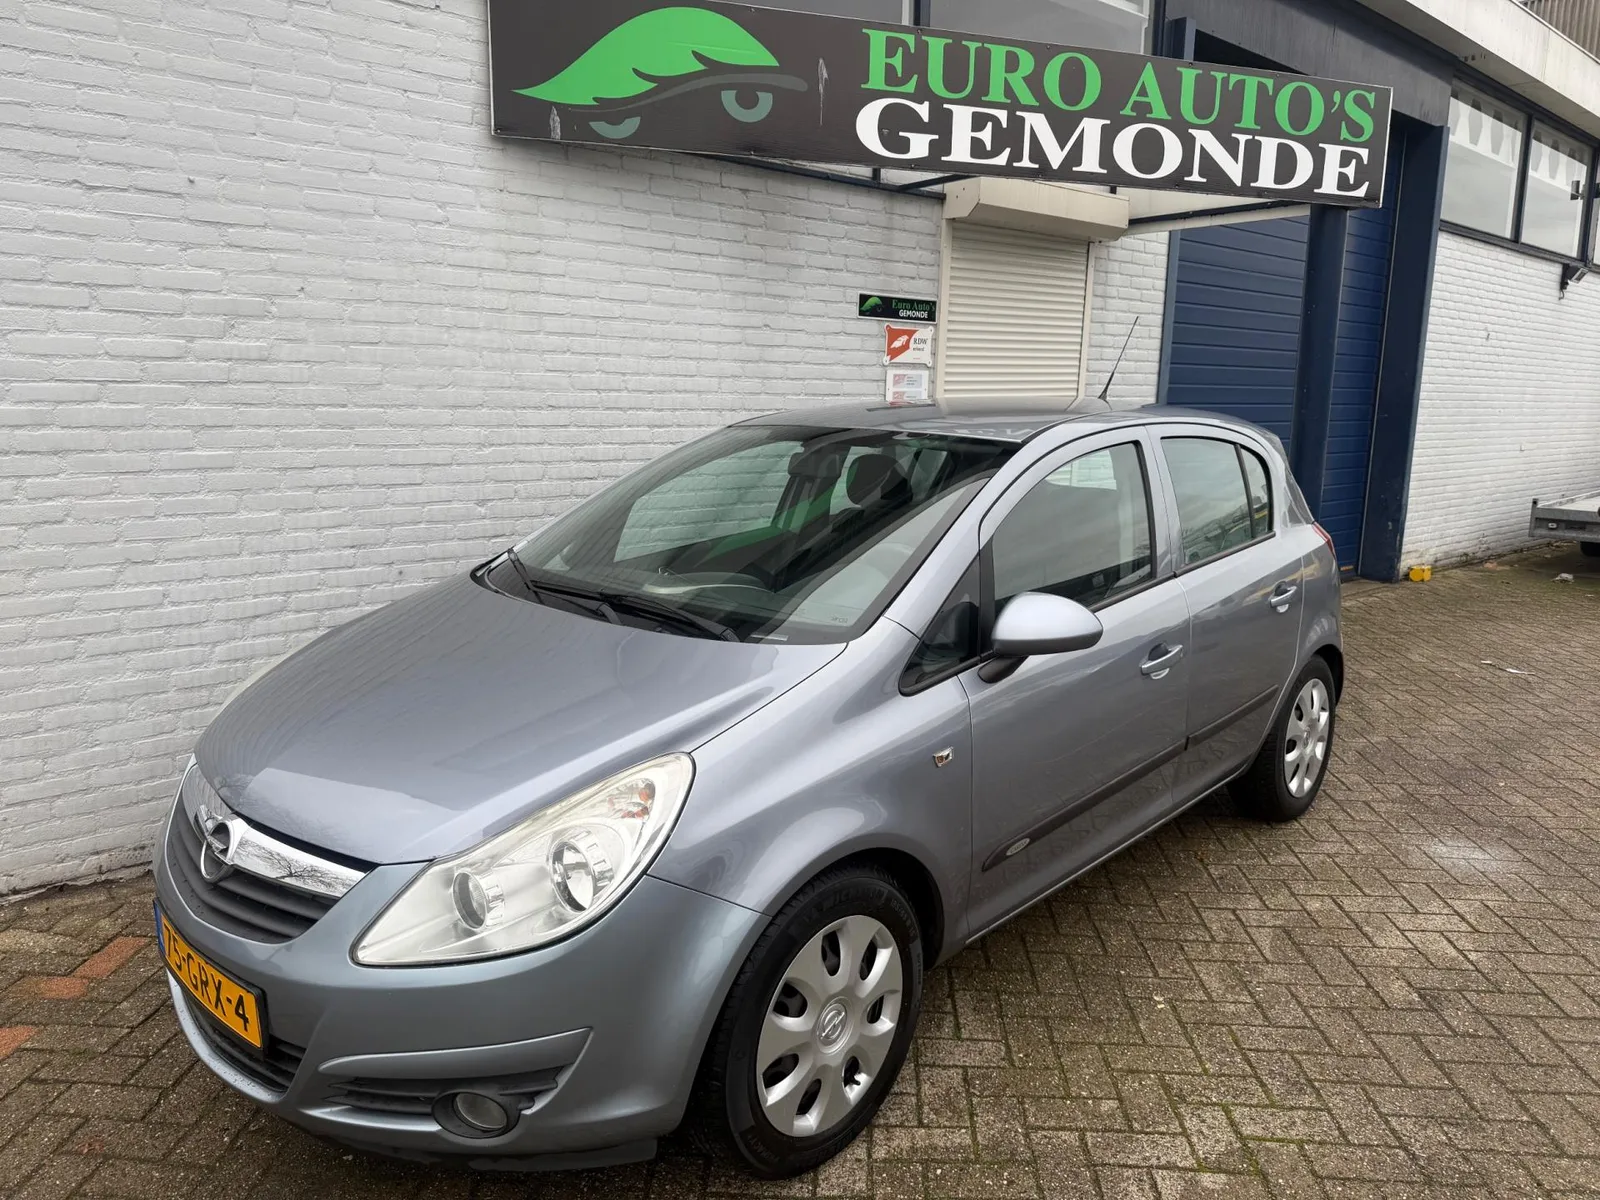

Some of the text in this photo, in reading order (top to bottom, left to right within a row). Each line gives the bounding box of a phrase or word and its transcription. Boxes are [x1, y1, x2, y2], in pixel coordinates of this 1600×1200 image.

[861, 27, 1377, 142] EURO AUTO'S
[855, 97, 1370, 197] GEMONDE
[892, 299, 935, 311] Euro Auto's
[898, 309, 928, 318] GEMONDE
[913, 337, 928, 345] RDW
[163, 923, 250, 1032] 75-GRX-4
